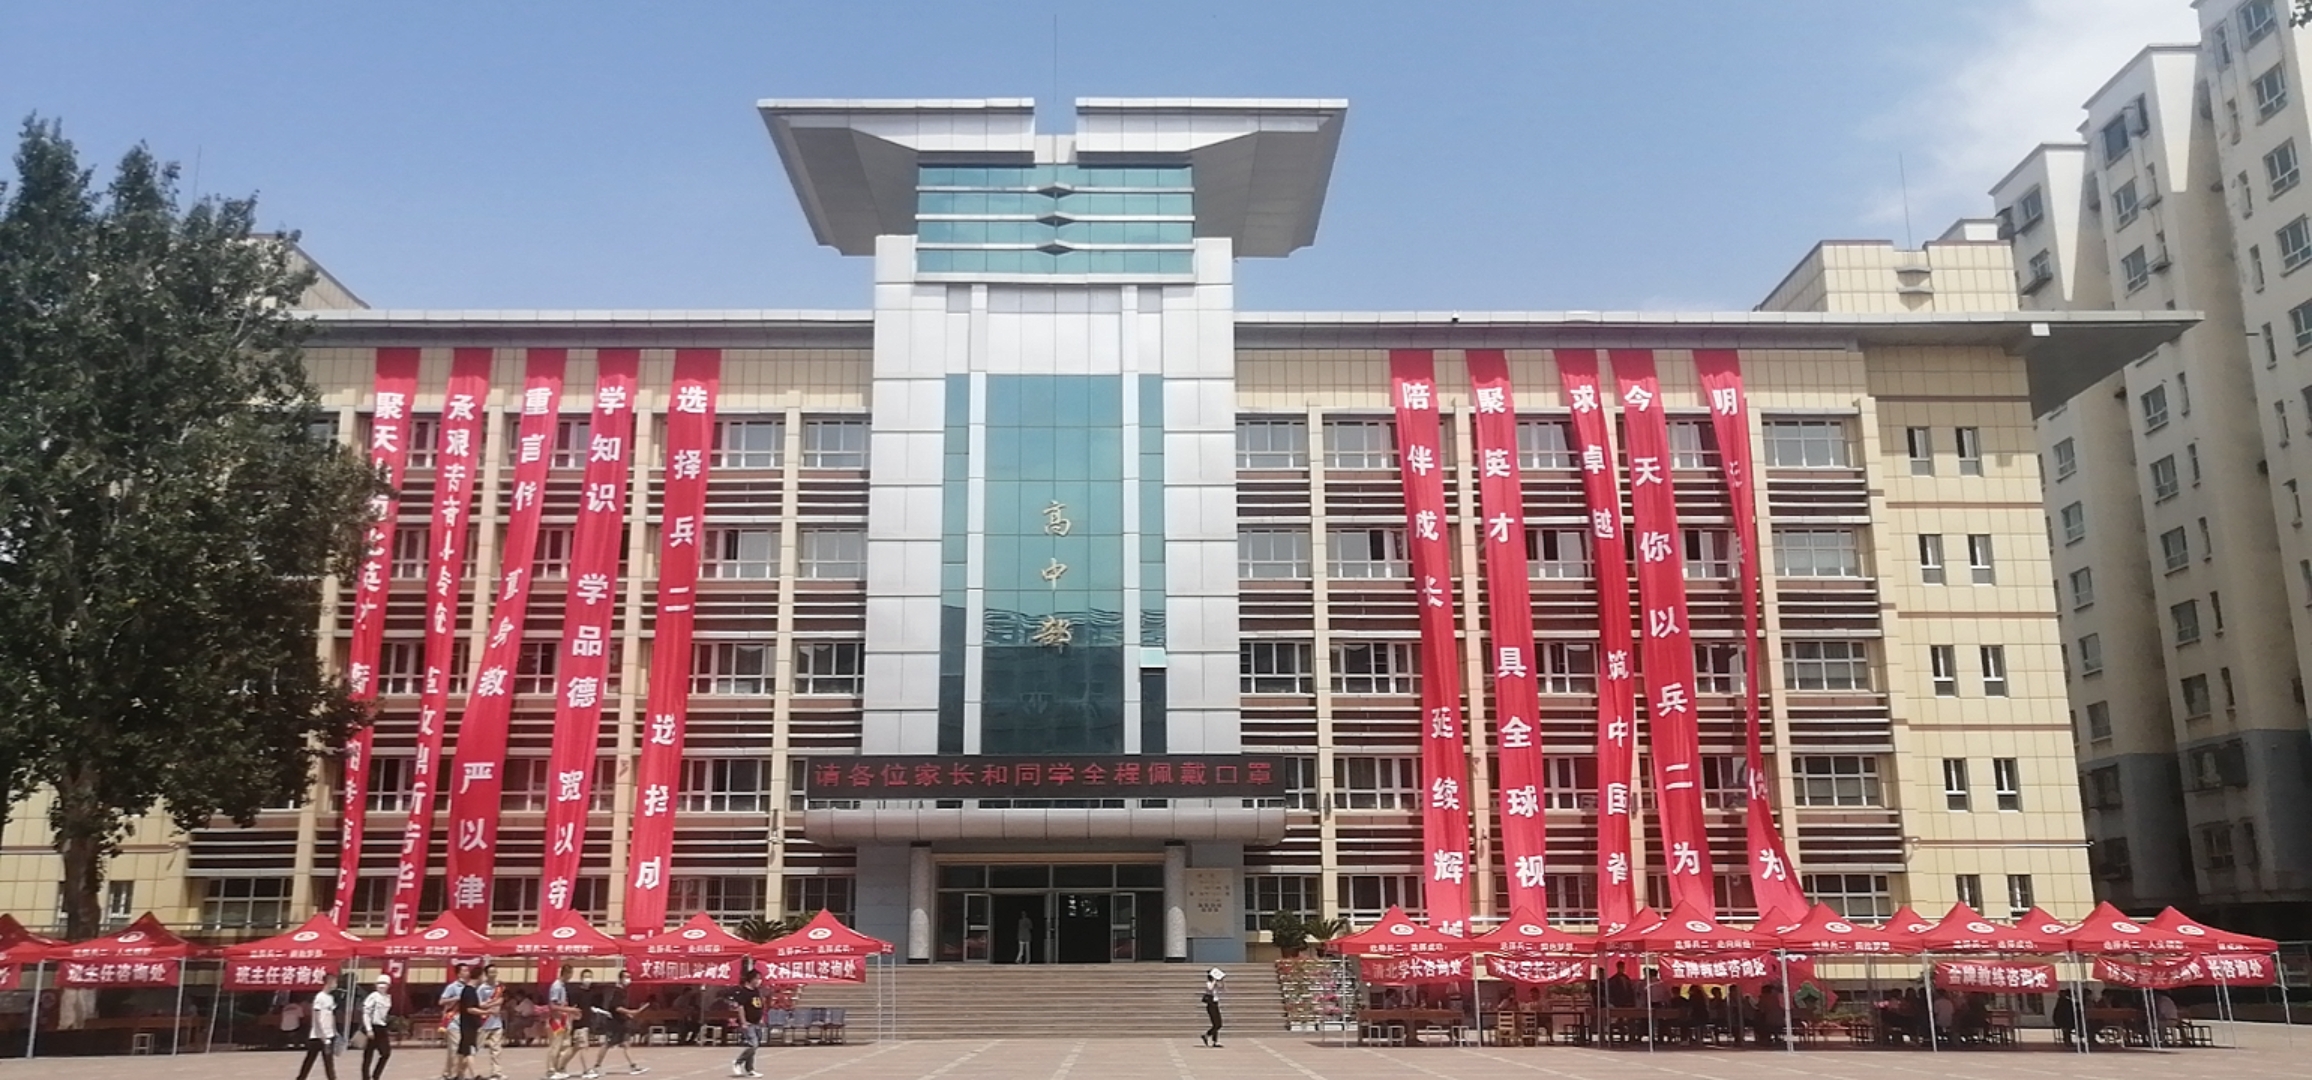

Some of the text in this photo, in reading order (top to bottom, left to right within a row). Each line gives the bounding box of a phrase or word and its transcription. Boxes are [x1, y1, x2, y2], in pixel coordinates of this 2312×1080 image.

[665, 386, 708, 612] 选择兵二
[1402, 383, 1444, 607] 陪伴成长
[1033, 499, 1073, 653] 高中部
[1623, 385, 1701, 875] 今天你以兵二为
[814, 762, 1274, 787] 请各位家长和同学全程佩戴口罩
[66, 962, 167, 983] 班主任咨询处
[235, 965, 326, 985] 班主任咨询处
[639, 960, 731, 979] 文科团队咨询处
[765, 960, 856, 979] 文科团队咨询处
[1373, 959, 1463, 979] 清北学长咨询处
